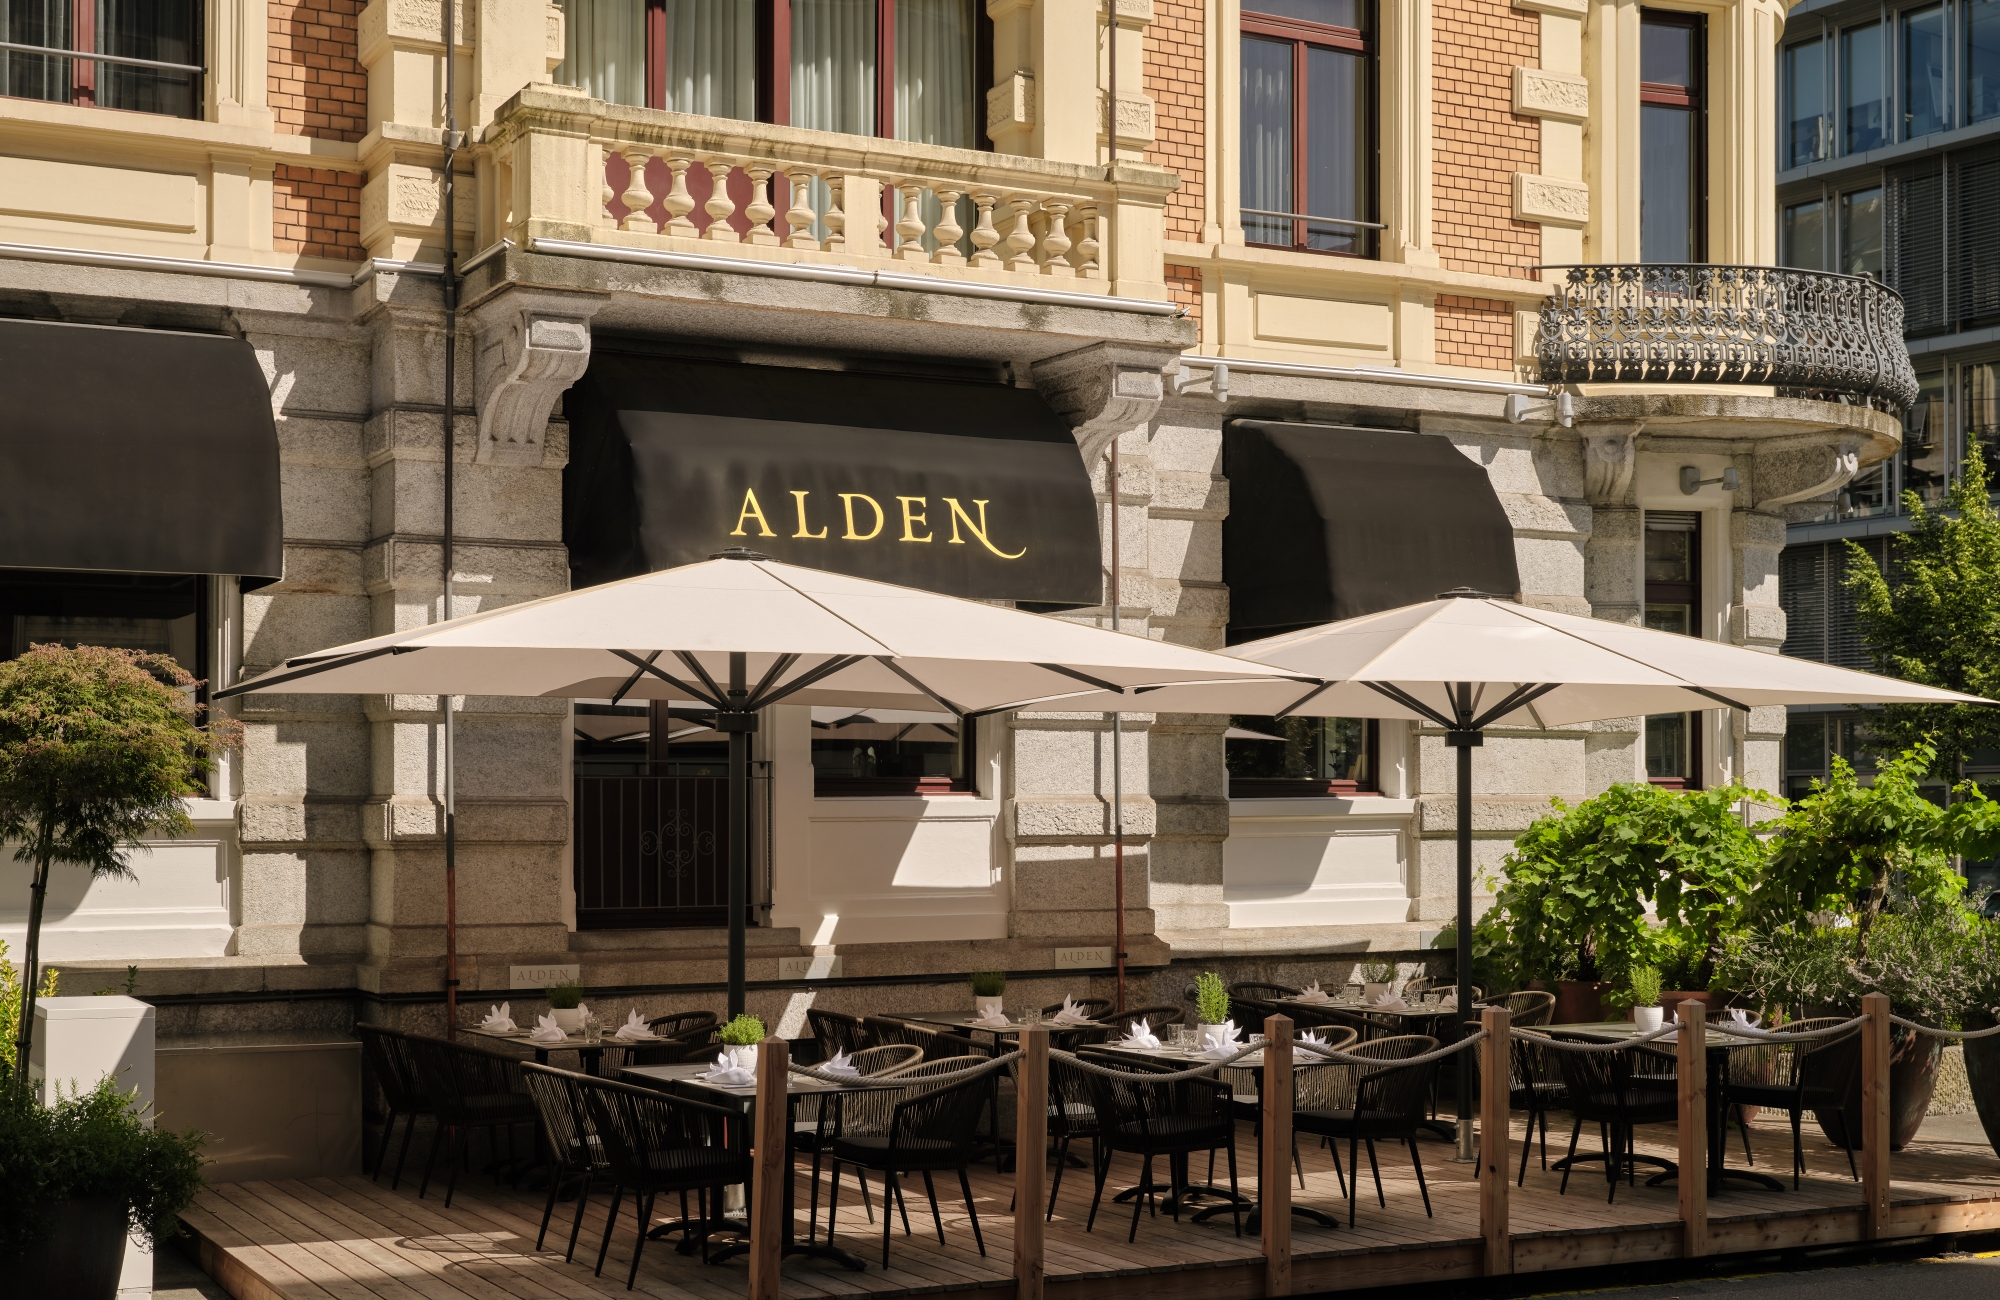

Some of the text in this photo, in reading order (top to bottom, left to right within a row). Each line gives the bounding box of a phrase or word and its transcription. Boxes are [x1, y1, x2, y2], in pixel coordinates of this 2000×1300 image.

[730, 488, 1026, 559] ALDEN
[1425, 933, 1457, 944] ALDE
[1060, 951, 1108, 963] ALDEN
[785, 961, 838, 974] ALDEN
[517, 969, 571, 983] ALDEN
